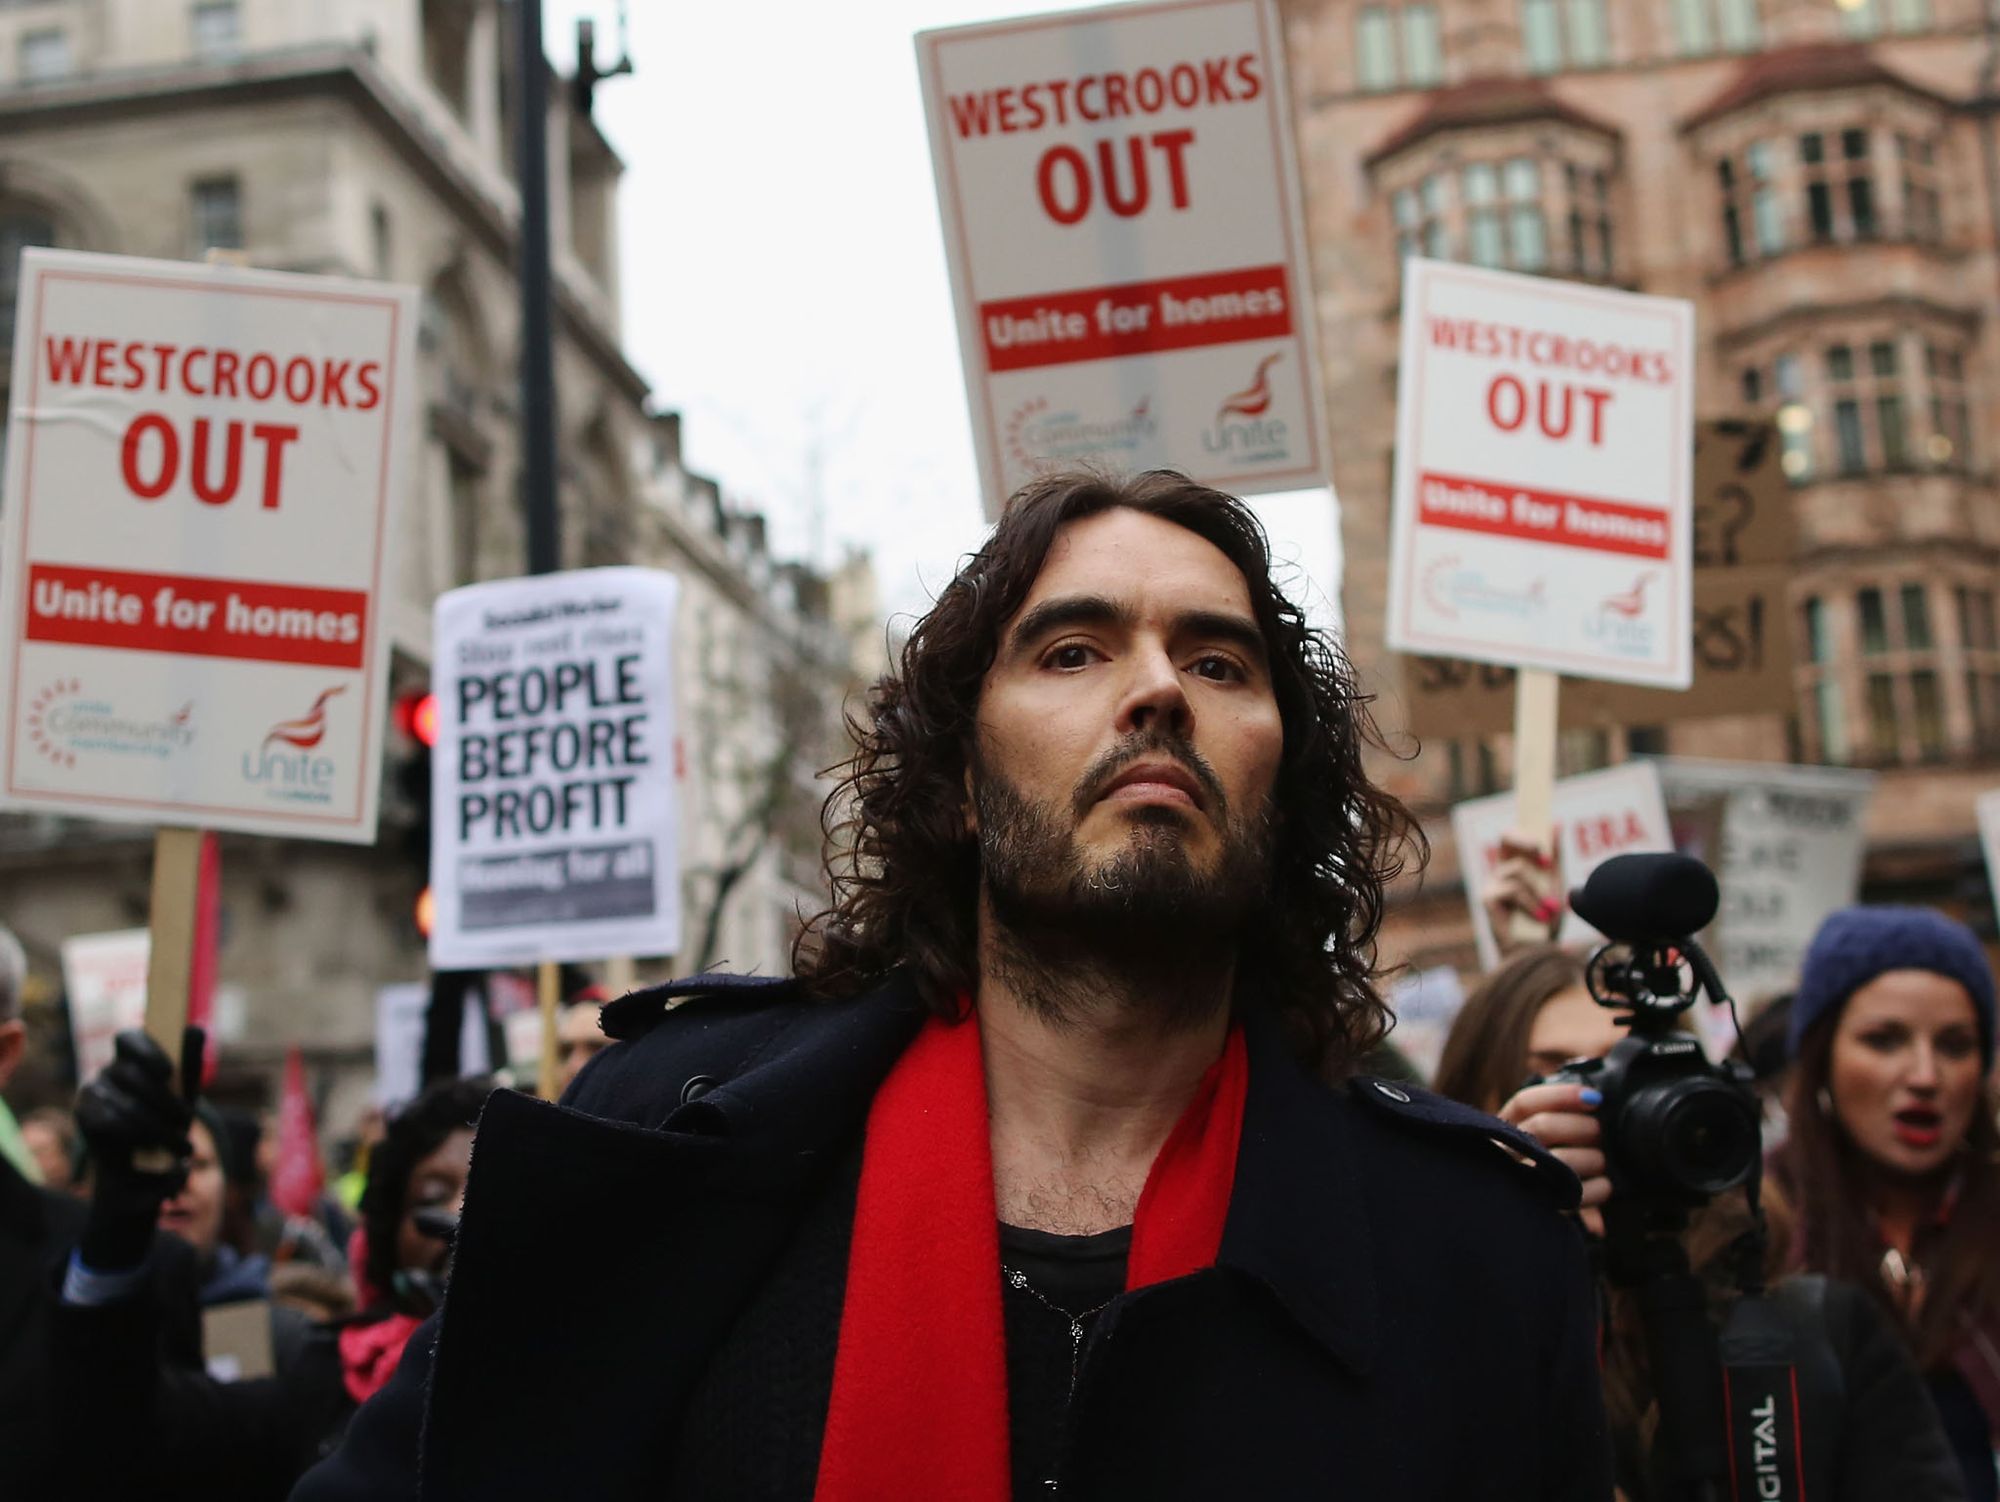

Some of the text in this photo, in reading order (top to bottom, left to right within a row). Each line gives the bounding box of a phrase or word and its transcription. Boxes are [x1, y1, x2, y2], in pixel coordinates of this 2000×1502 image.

[950, 53, 1263, 139] WESTCROOKS
[1037, 128, 1195, 225] OUT
[988, 286, 1283, 347] Unite for homes
[1428, 318, 1674, 384] WESTCROOKS
[46, 336, 381, 410] WESTCROOKS
[1488, 373, 1613, 446] OUT
[120, 411, 300, 510] OUT
[1423, 482, 1666, 547] Unite for homes
[34, 579, 360, 643] Unite for homes
[457, 653, 644, 724] PEOPLE
[460, 713, 649, 781] BEFORE
[460, 777, 637, 841] PROFIT
[1751, 1394, 1781, 1502] GITAL
